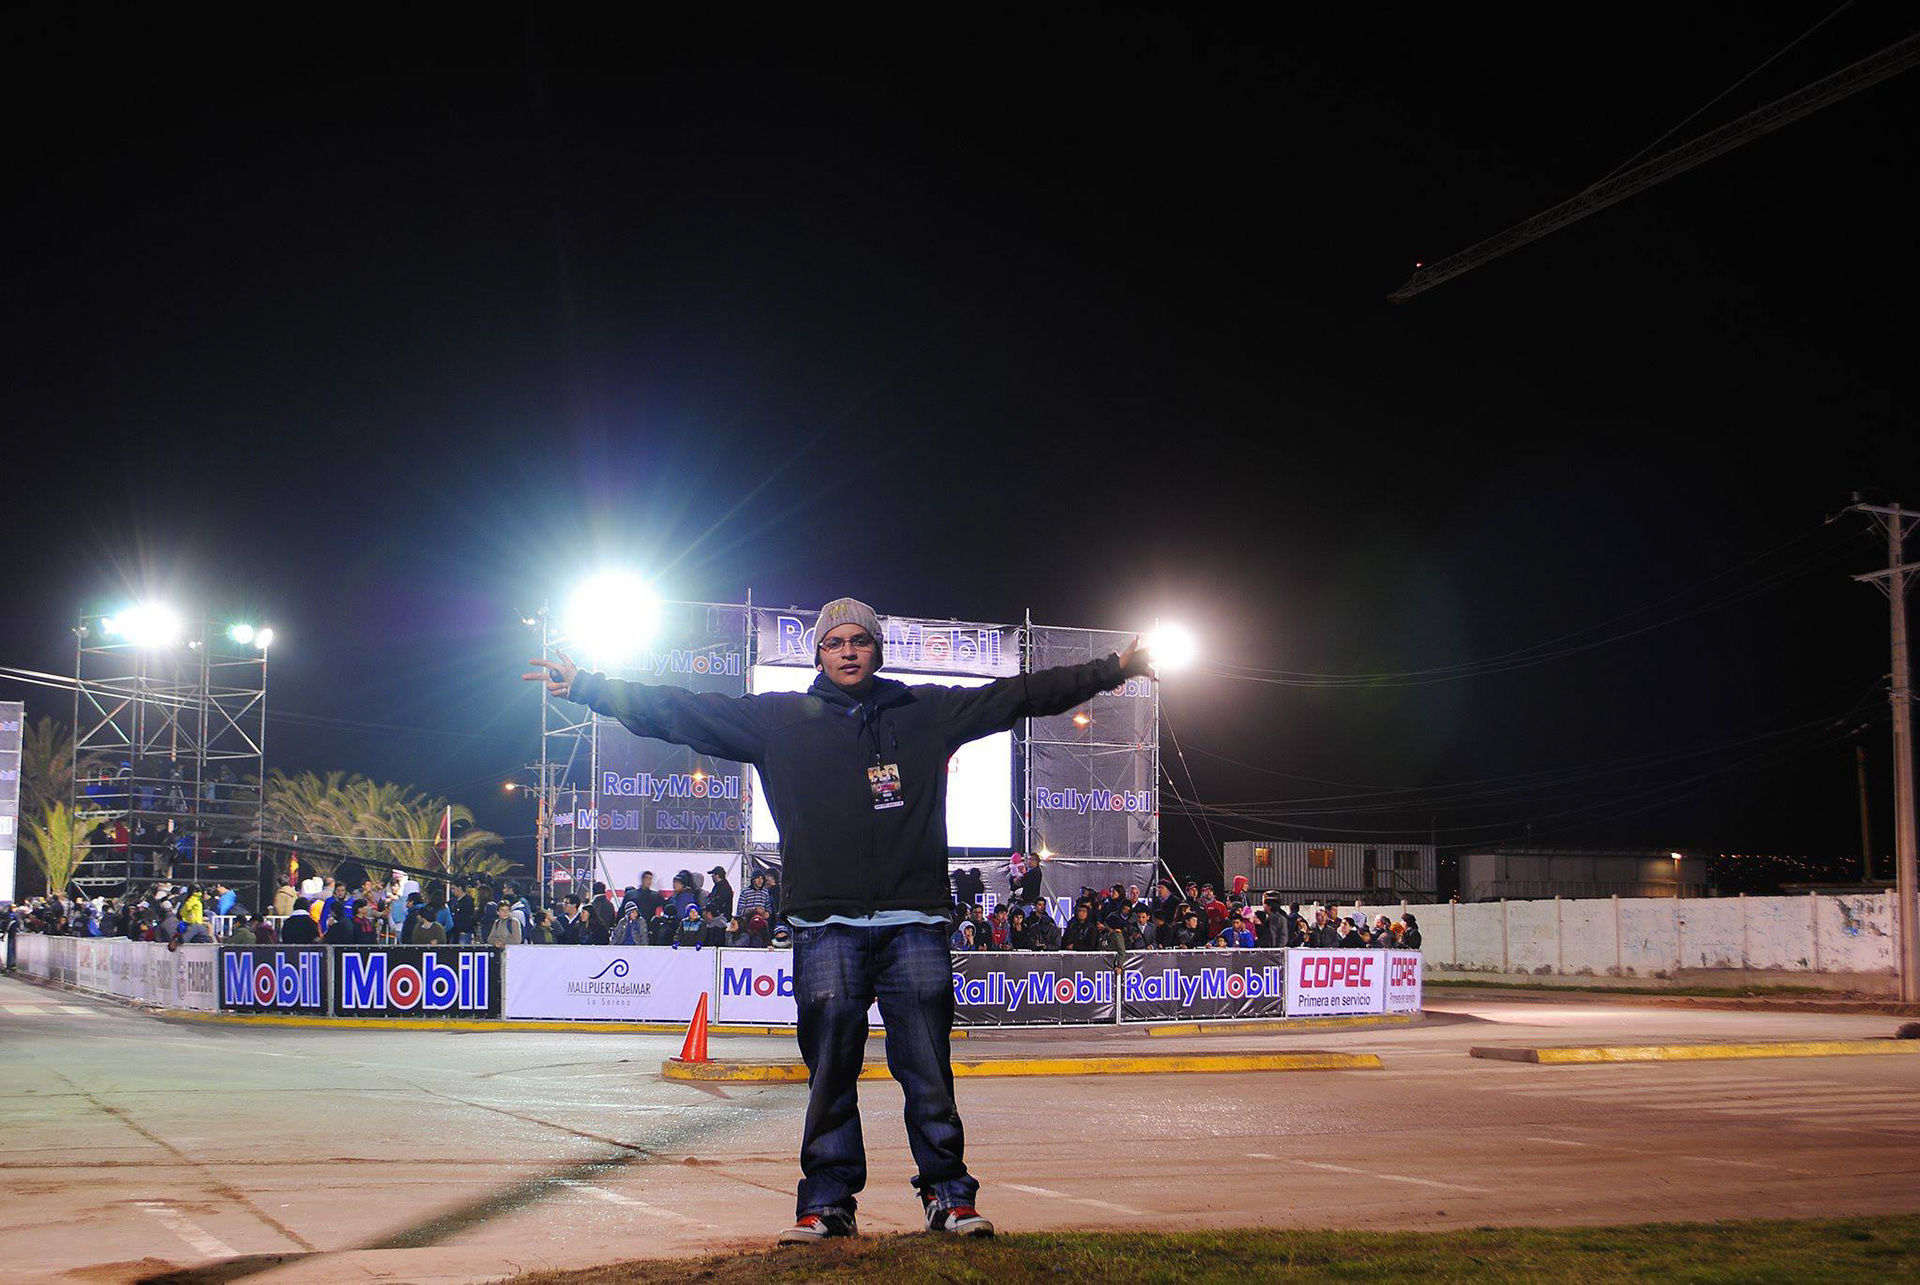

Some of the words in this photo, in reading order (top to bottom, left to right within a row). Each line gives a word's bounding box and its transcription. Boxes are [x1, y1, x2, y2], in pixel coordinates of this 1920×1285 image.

[603, 771, 739, 801] RallyMobil
[1036, 786, 1151, 815] RallyMobil
[578, 809, 639, 830] Mobil
[224, 951, 321, 1007] Mobil
[341, 951, 489, 1010] Mobil
[724, 967, 794, 997] Mob
[1124, 966, 1280, 1007] RallyMobil
[1298, 994, 1330, 1007] Primera
[1330, 996, 1341, 1006] en
[1342, 993, 1371, 1006] servicio
